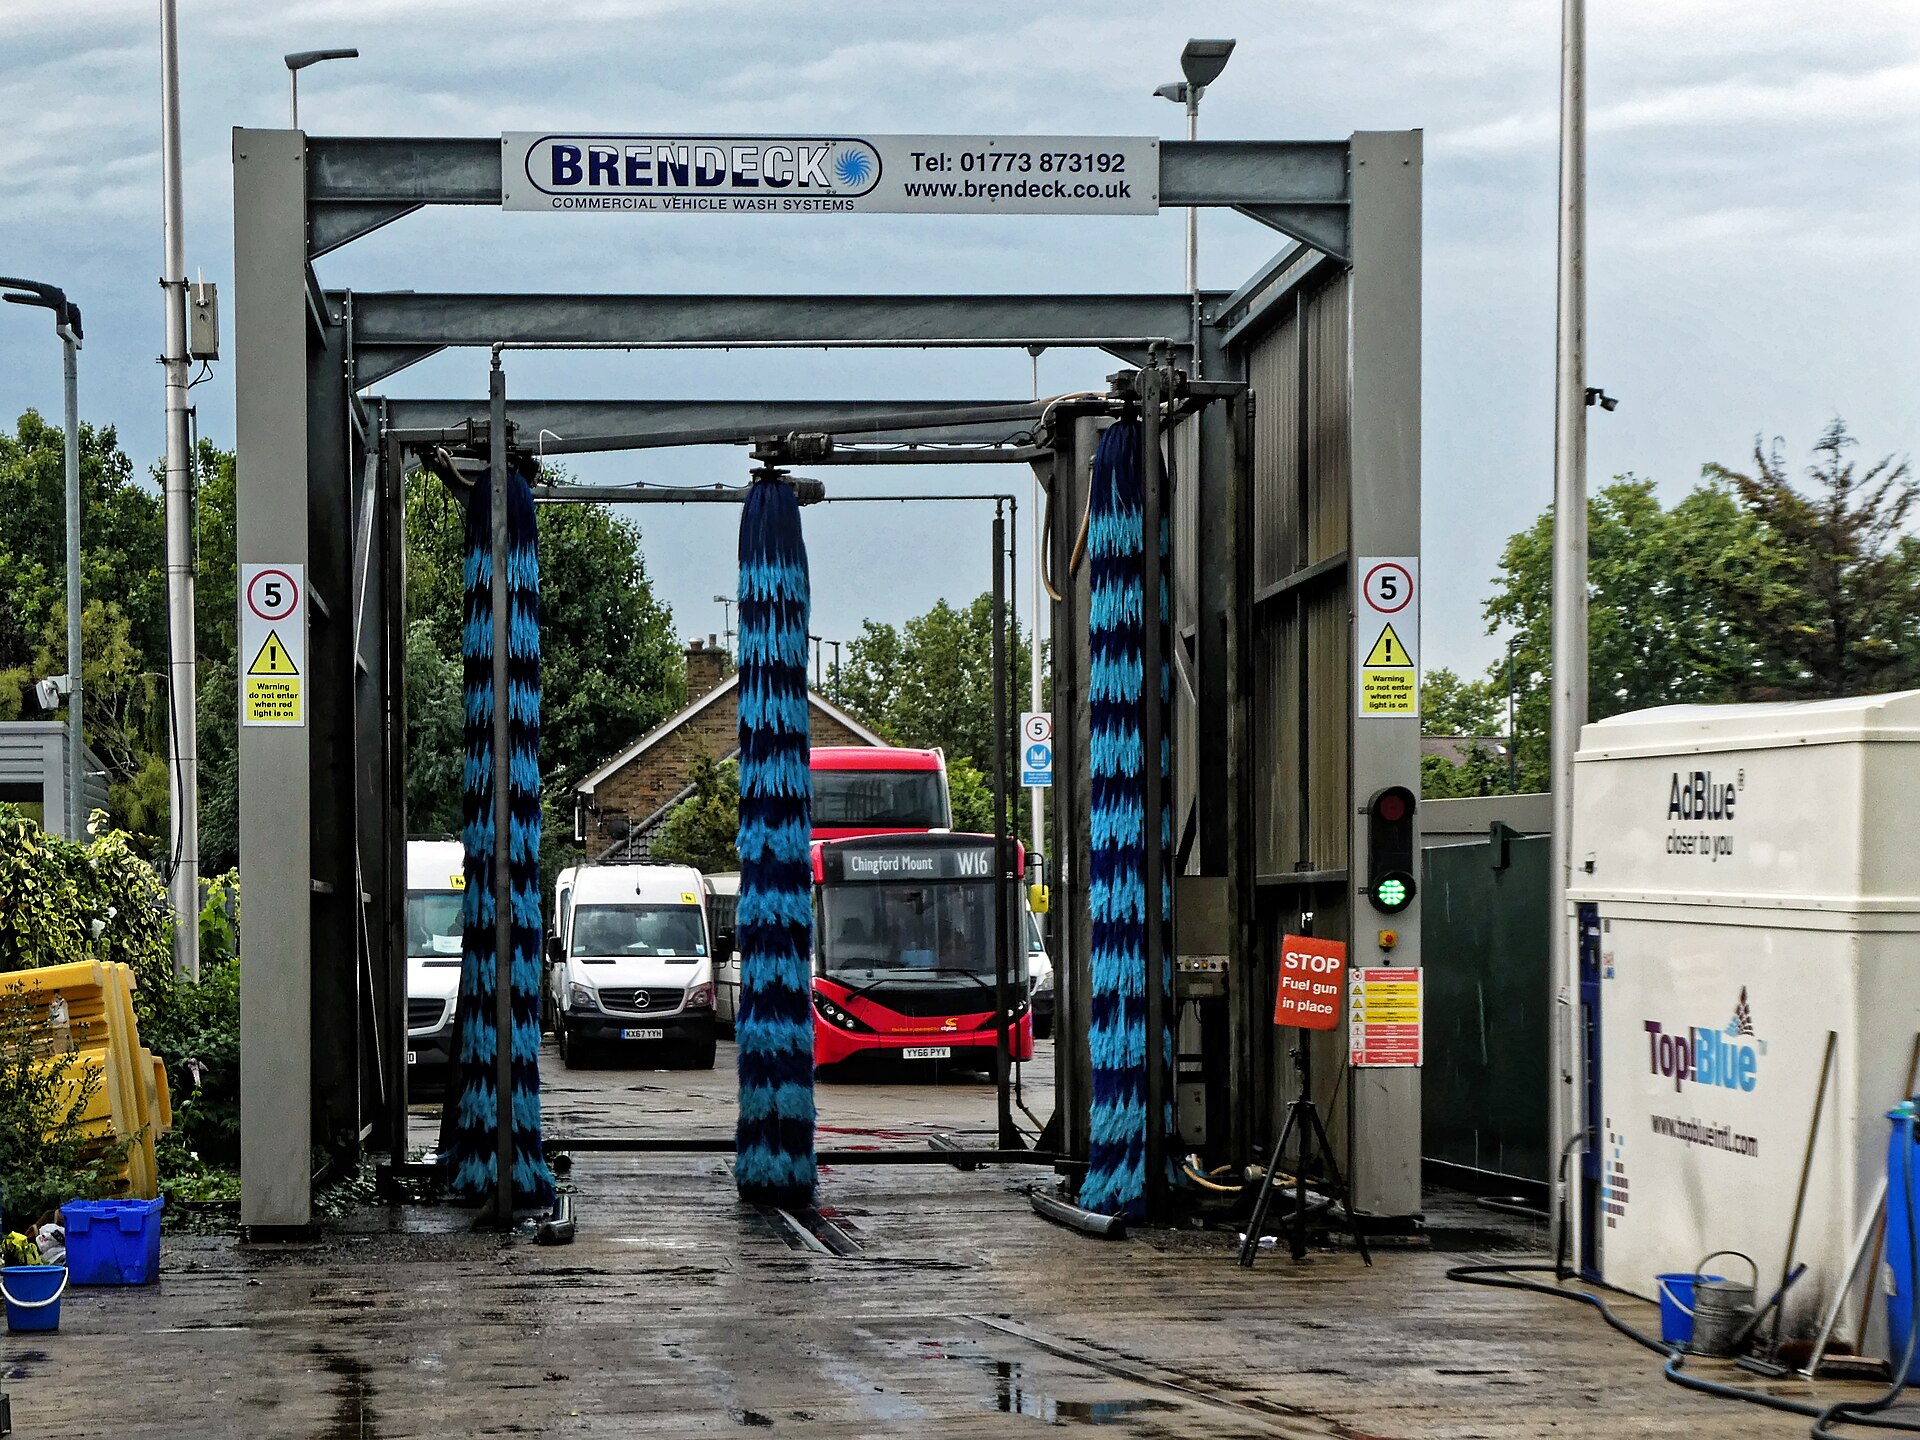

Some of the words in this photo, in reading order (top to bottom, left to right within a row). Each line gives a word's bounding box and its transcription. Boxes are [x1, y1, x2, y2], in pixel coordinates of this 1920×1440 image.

[552, 144, 832, 188] BRENDECK
[910, 152, 952, 172] Tel:
[960, 152, 1032, 172] 01773
[1039, 153, 1126, 173] 873192
[904, 180, 1132, 199] www.brendeck.co.uk
[552, 197, 658, 209] COMMERCIAL
[663, 198, 727, 210] VEHICLE
[733, 199, 777, 210] WASH
[783, 199, 855, 211] SYSTEMS
[264, 583, 282, 607] 5
[1380, 576, 1397, 600] 5
[257, 683, 290, 691] Warning
[1372, 675, 1405, 683] Warning
[254, 709, 272, 718] light
[1369, 701, 1387, 710] light
[1034, 723, 1043, 736] 5
[1666, 828, 1697, 855] closer
[1699, 830, 1711, 855] to
[1712, 835, 1734, 863] you
[851, 855, 899, 875] Chingford
[902, 856, 933, 870] Mount
[957, 851, 988, 875] W16
[1285, 952, 1340, 974] STOP
[1282, 976, 1310, 991] Fuel
[1313, 983, 1338, 995] gun
[1282, 997, 1294, 1009] in
[1297, 999, 1333, 1014] place
[907, 1048, 929, 1057] YY66
[930, 1048, 946, 1056] PYV
